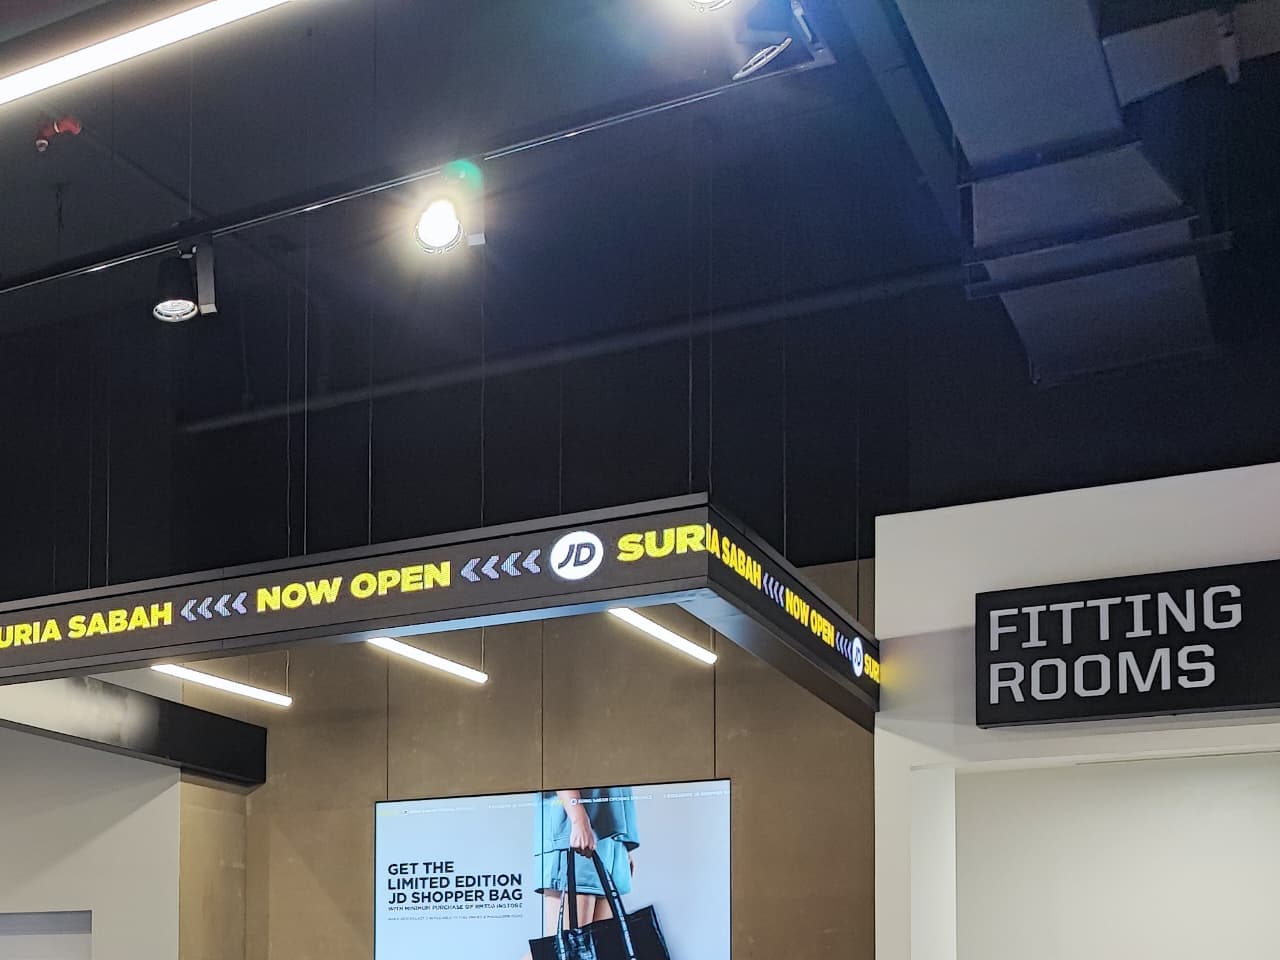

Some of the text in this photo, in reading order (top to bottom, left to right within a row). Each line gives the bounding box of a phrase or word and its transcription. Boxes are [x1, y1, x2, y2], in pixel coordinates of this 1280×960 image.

[67, 602, 172, 639] SABAH
[256, 574, 342, 614] NOW
[350, 560, 451, 599] OPEN
[721, 536, 762, 591] SABAH
[785, 587, 810, 628] NOW
[810, 608, 835, 649] OPEN
[864, 653, 881, 684] SUR
[989, 584, 1243, 652] FITTING
[989, 643, 1216, 705] ROOMS
[387, 861, 455, 876] GET THE
[387, 873, 523, 891] LIMITED EDITION
[388, 888, 523, 905] JD SHOPPER BAG
